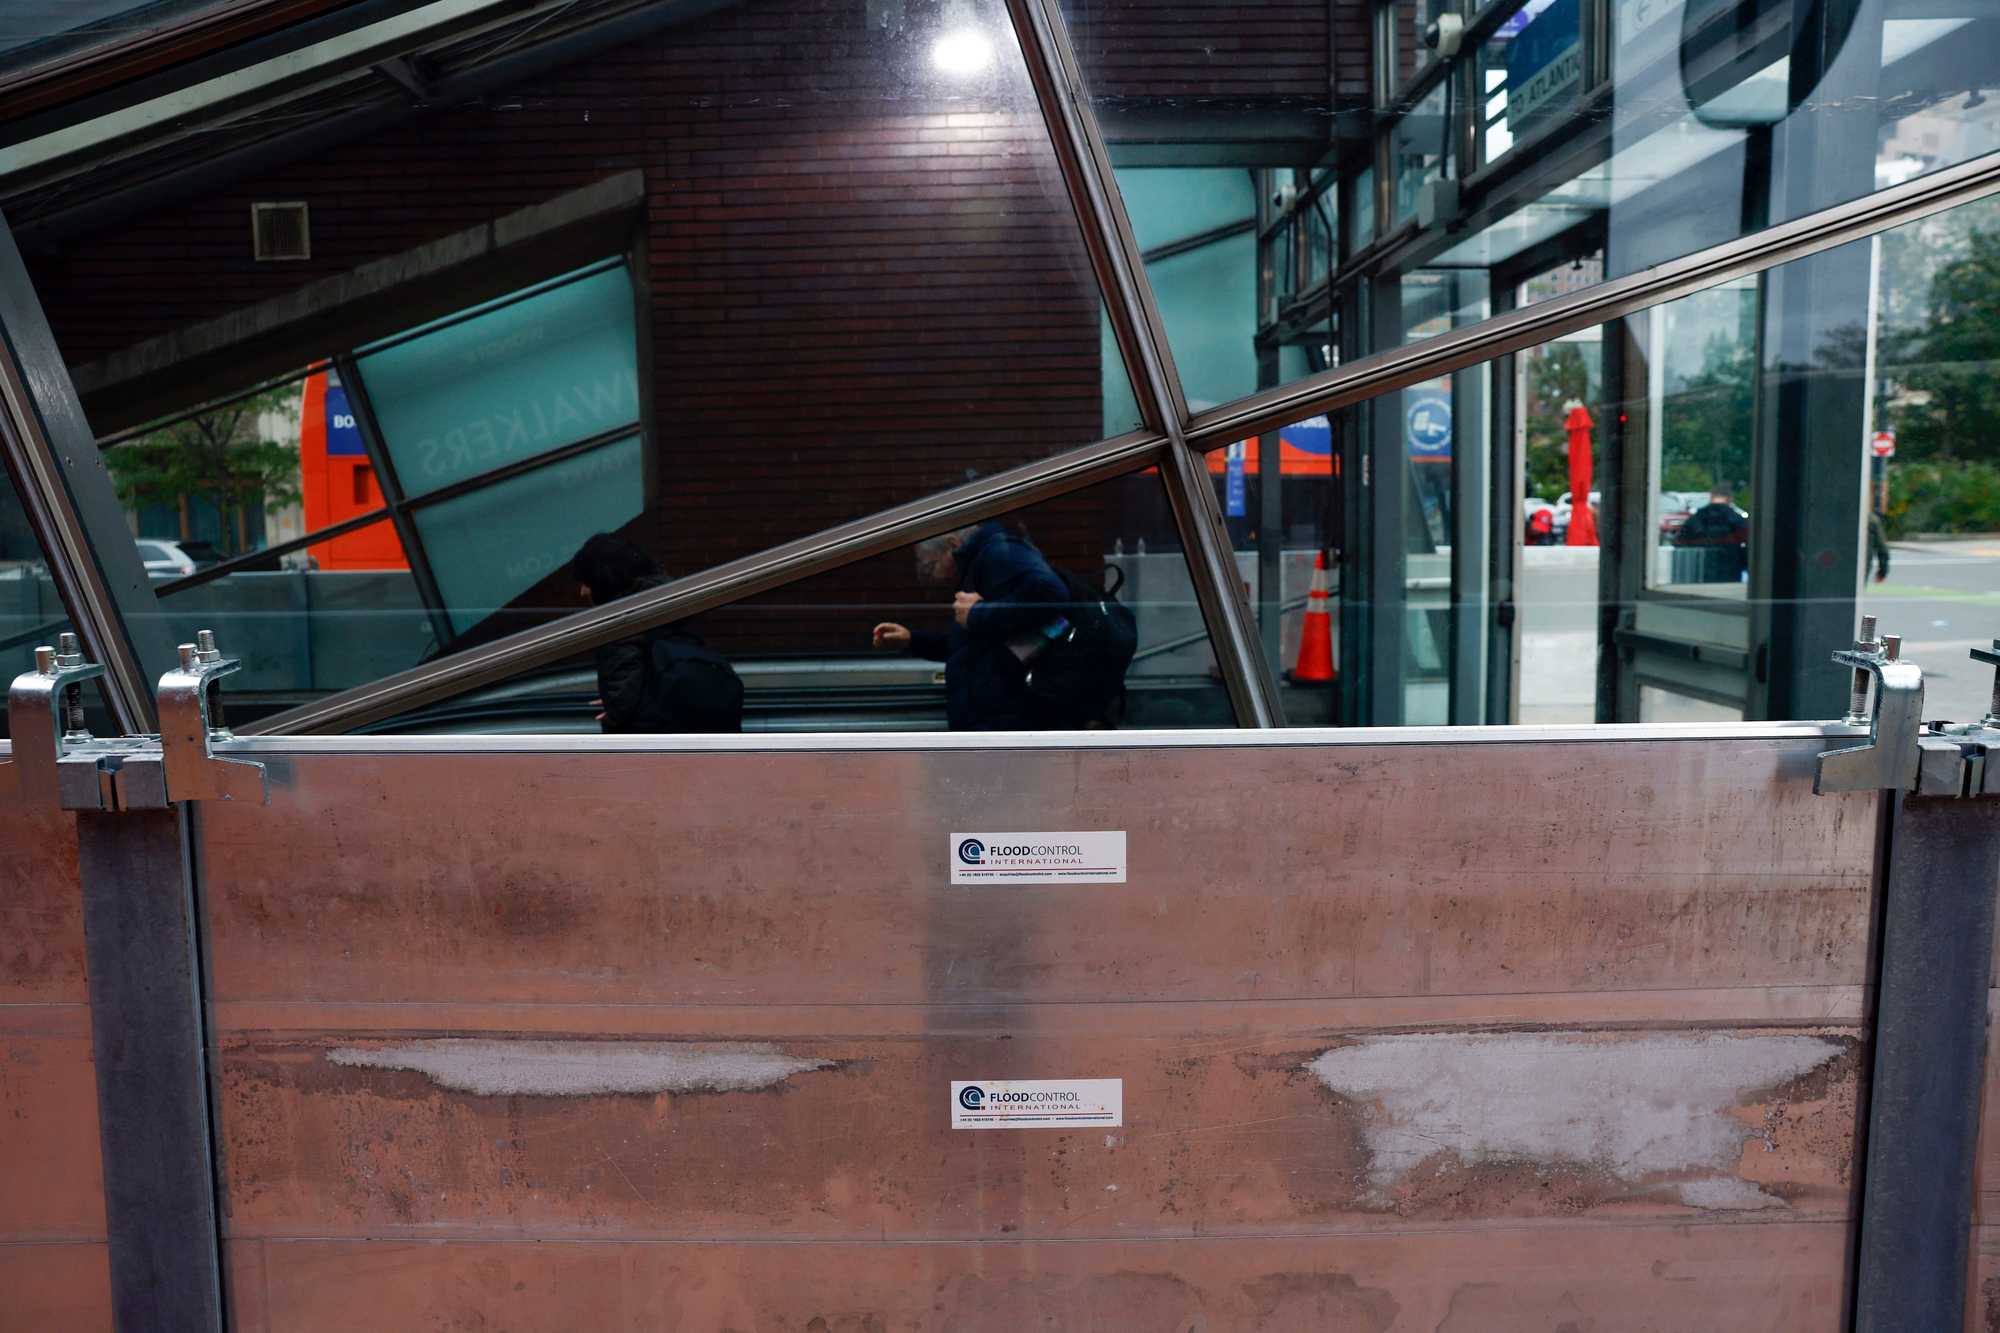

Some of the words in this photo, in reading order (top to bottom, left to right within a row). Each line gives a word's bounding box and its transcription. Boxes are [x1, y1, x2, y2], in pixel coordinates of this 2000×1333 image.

[333, 414, 356, 429] BO
[990, 845, 1084, 857] FLOODCONTROL
[990, 1091, 1081, 1103] FLOODCONTROL
